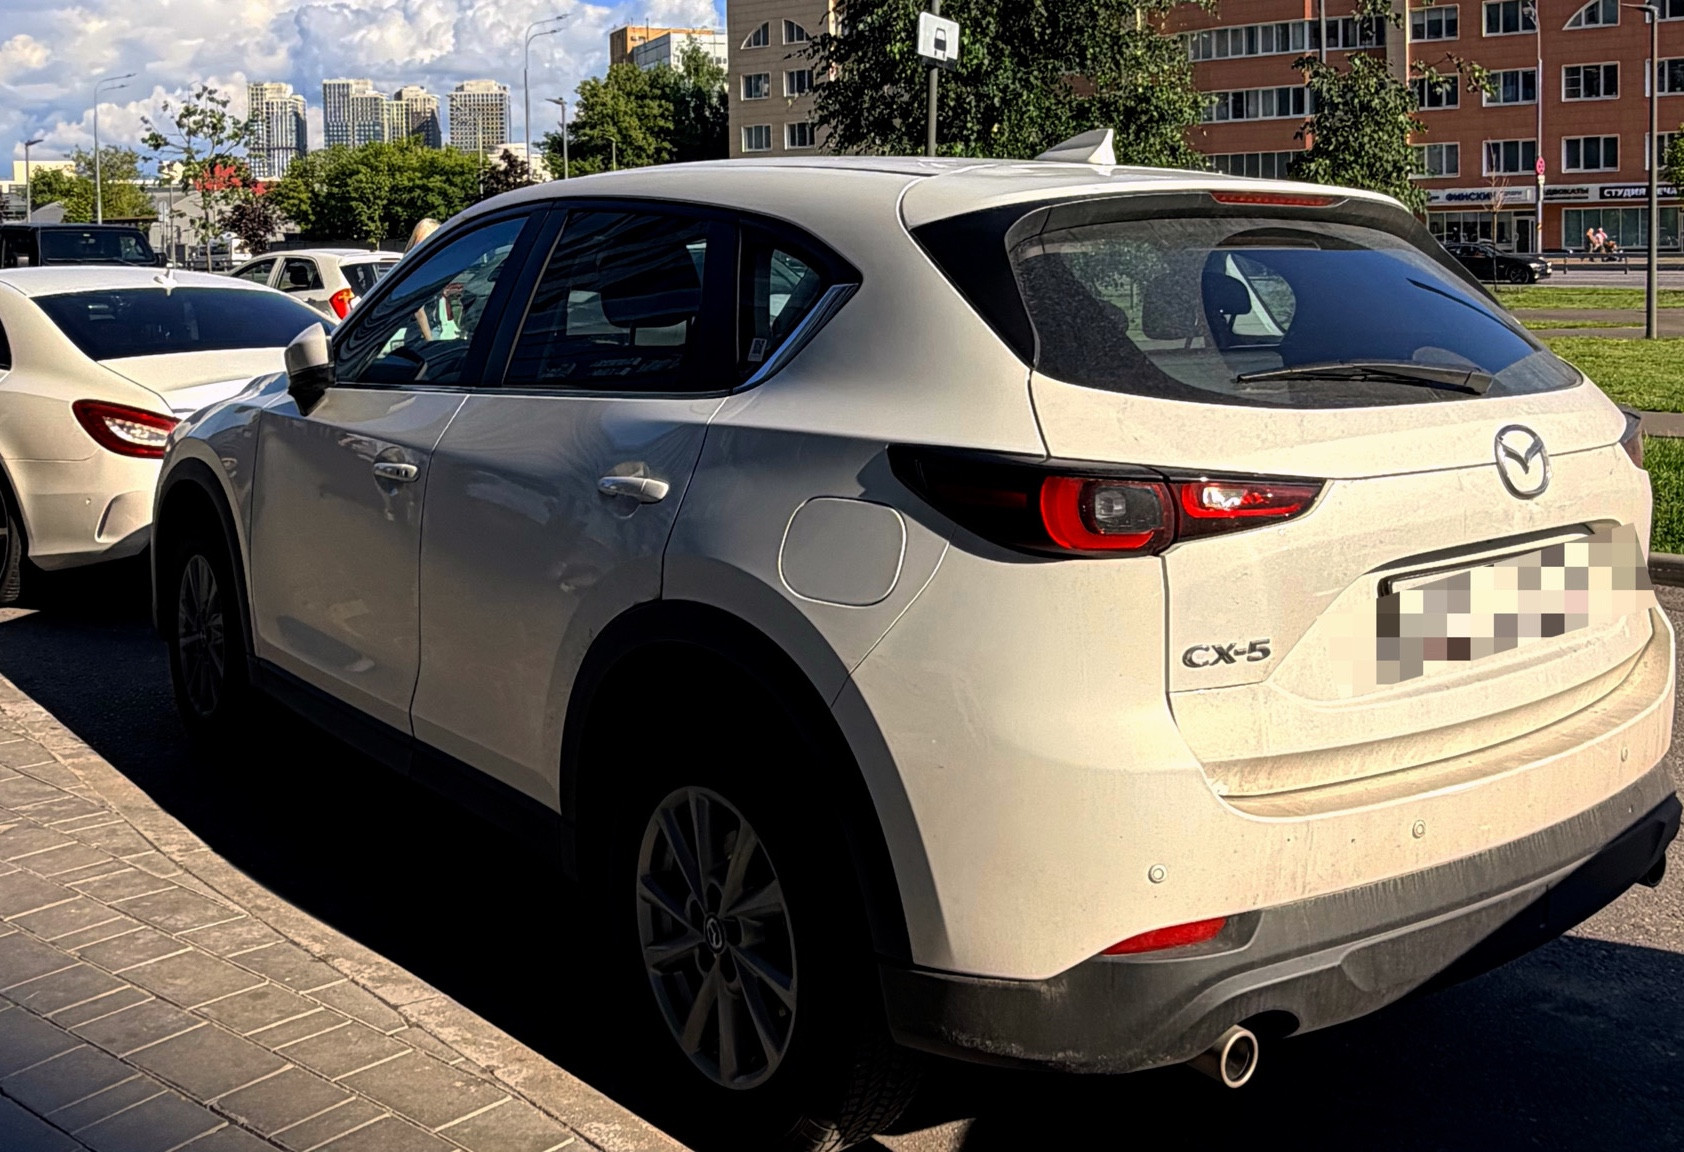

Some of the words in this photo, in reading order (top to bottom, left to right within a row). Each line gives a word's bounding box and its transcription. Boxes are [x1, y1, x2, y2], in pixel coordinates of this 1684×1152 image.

[1544, 187, 1589, 195] ДВОКАТЫ
[1604, 187, 1646, 197] СТУДИЯ
[1182, 638, 1271, 668] CX-5
